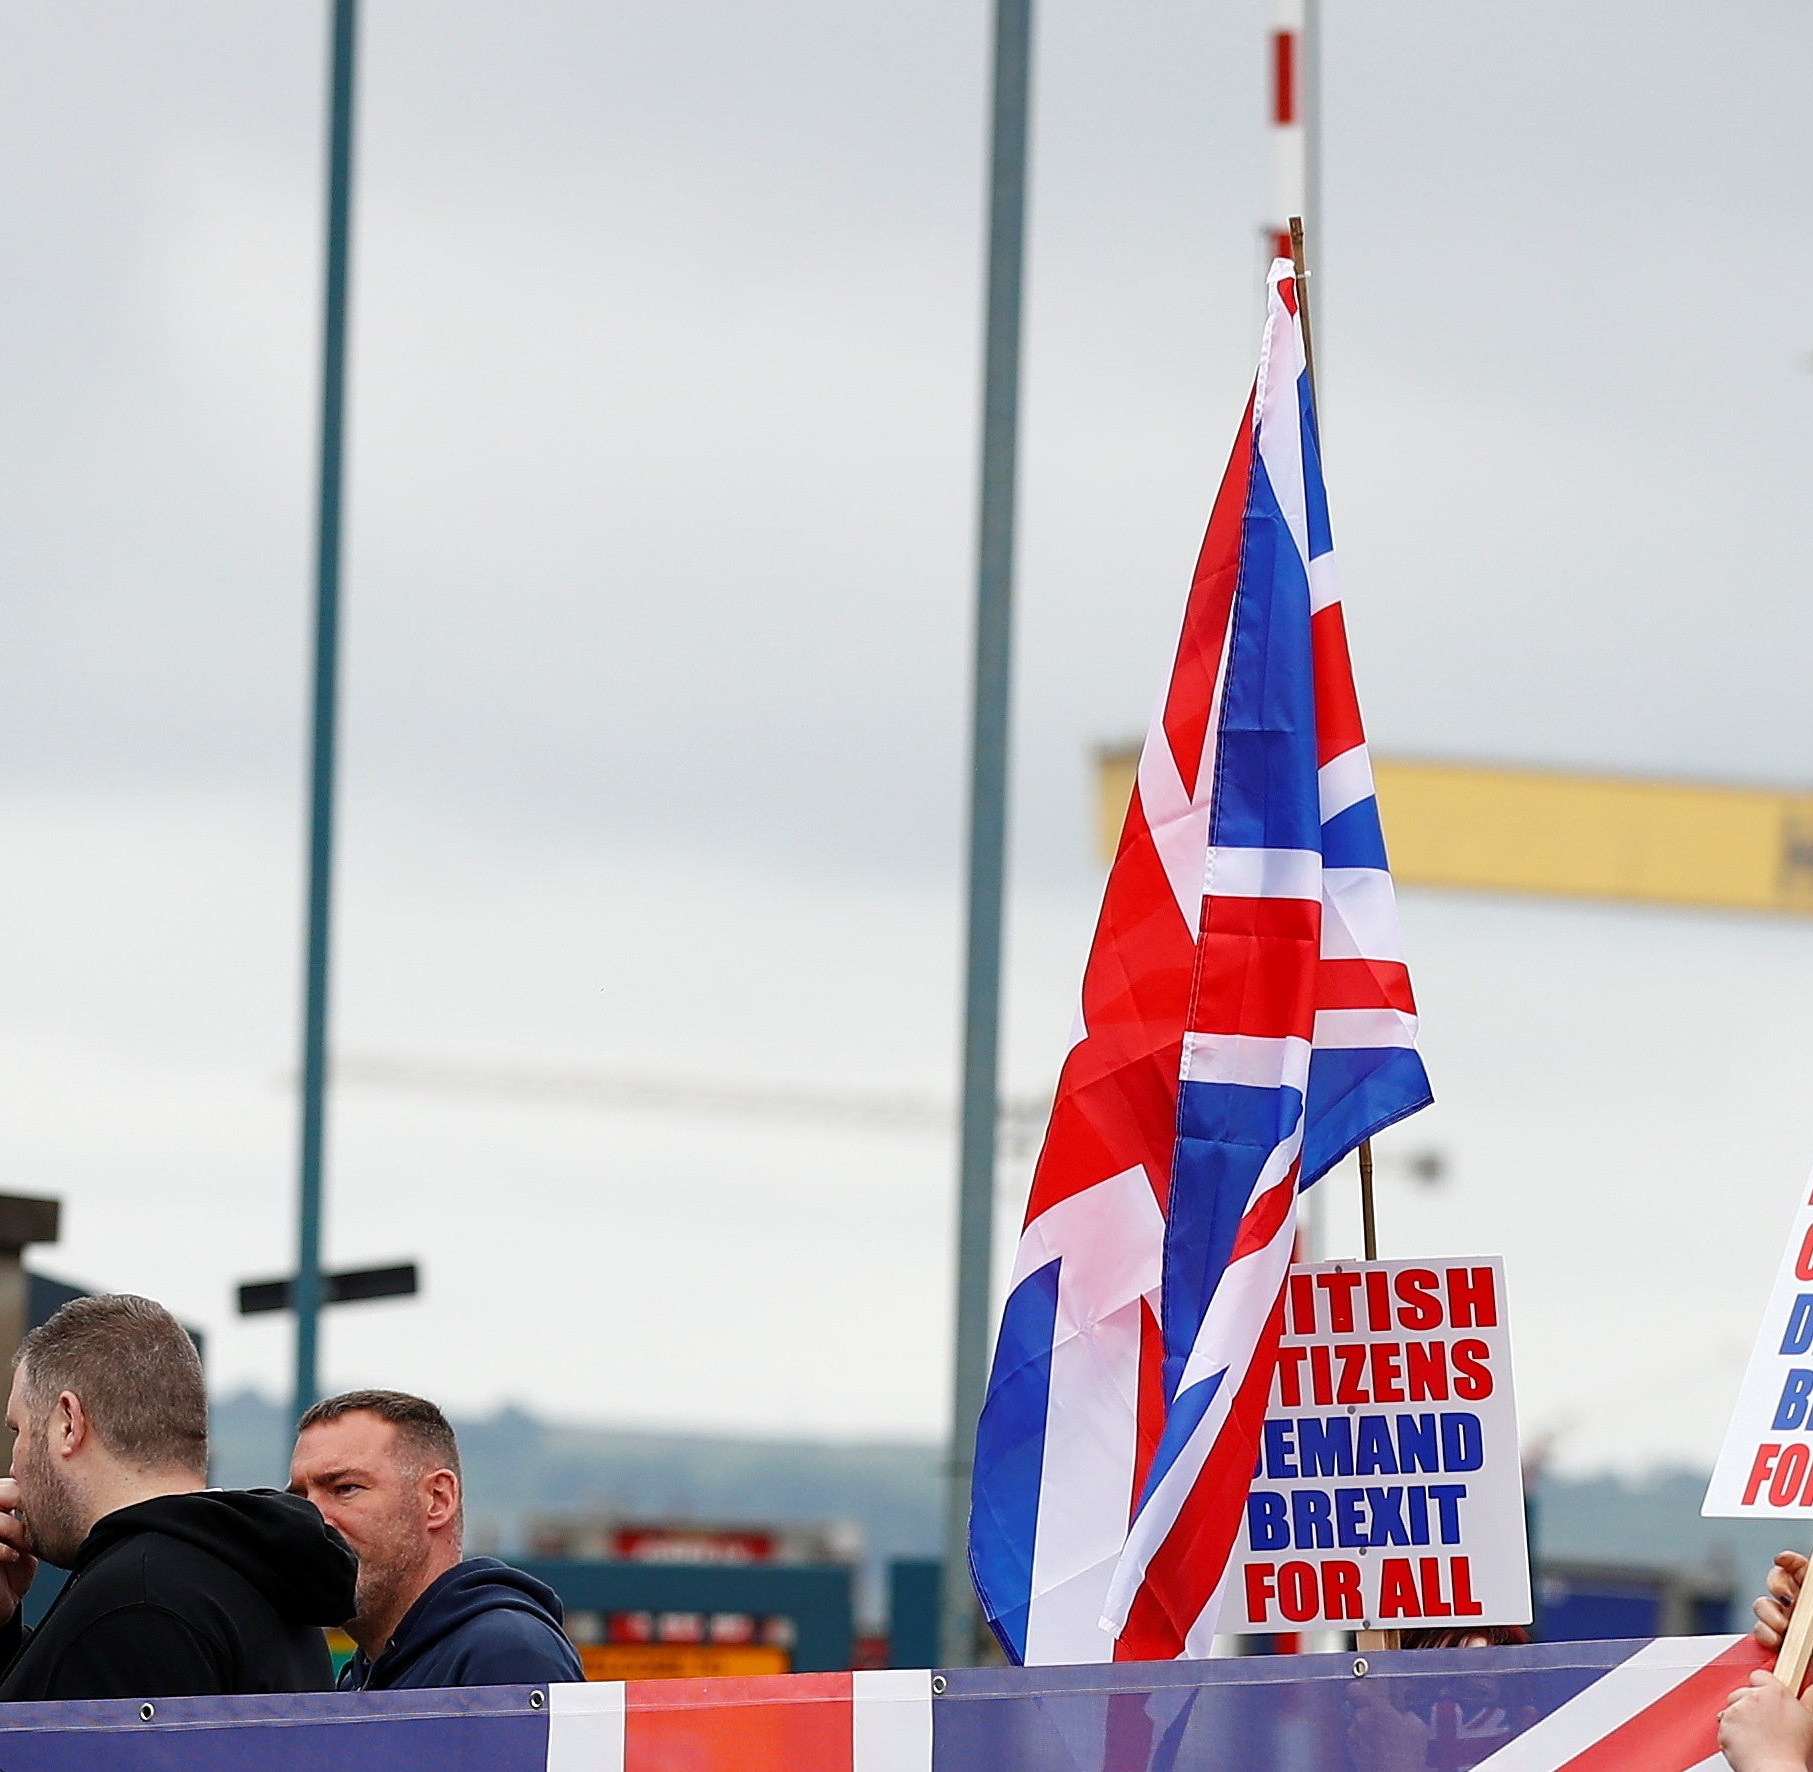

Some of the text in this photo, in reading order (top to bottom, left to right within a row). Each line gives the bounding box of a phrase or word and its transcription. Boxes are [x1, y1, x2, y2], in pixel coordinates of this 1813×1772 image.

[1285, 1266, 1498, 1335] ITISH
[1276, 1339, 1494, 1406] TIZENS
[1253, 1412, 1484, 1479] EMAND
[1247, 1484, 1467, 1552] BREXIT
[1244, 1556, 1483, 1623] FOR ALL
